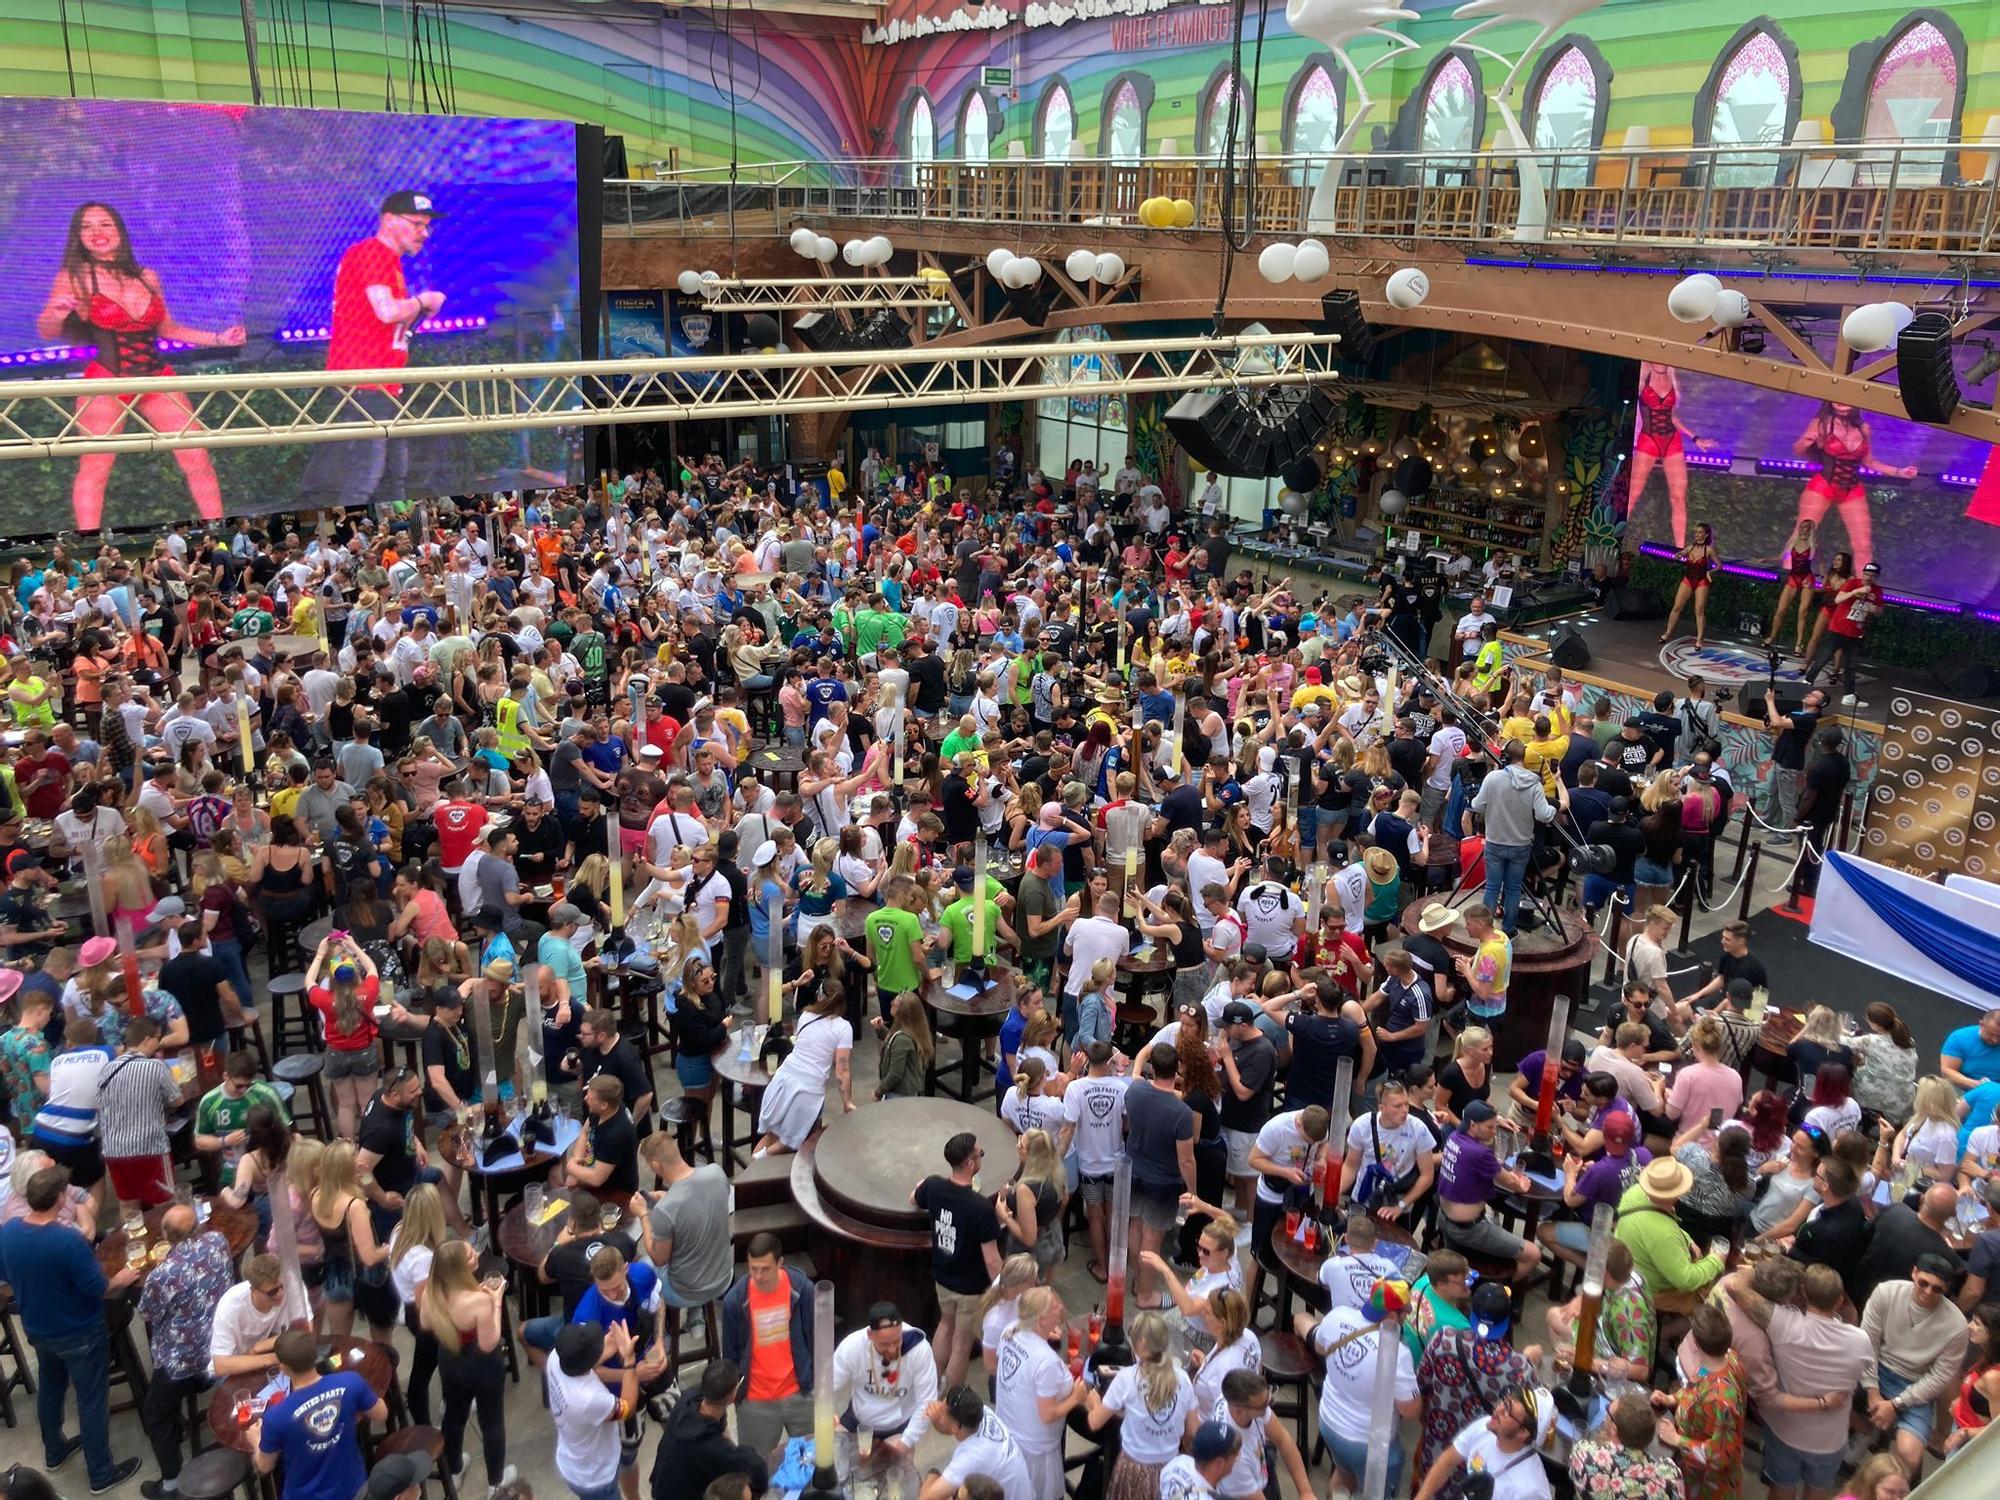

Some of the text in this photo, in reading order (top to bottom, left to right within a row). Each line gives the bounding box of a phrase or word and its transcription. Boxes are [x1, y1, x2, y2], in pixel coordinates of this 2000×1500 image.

[1110, 6, 1231, 51] WHITE FLAMINGO
[54, 1053, 101, 1065] SV MEPPEN
[1083, 1086, 1120, 1098] UNITED PARTY
[1092, 1101, 1110, 1109] MEGA
[215, 1108, 231, 1126] 18
[940, 1208, 953, 1225] NO
[293, 1386, 347, 1418] UNITED PARTY
